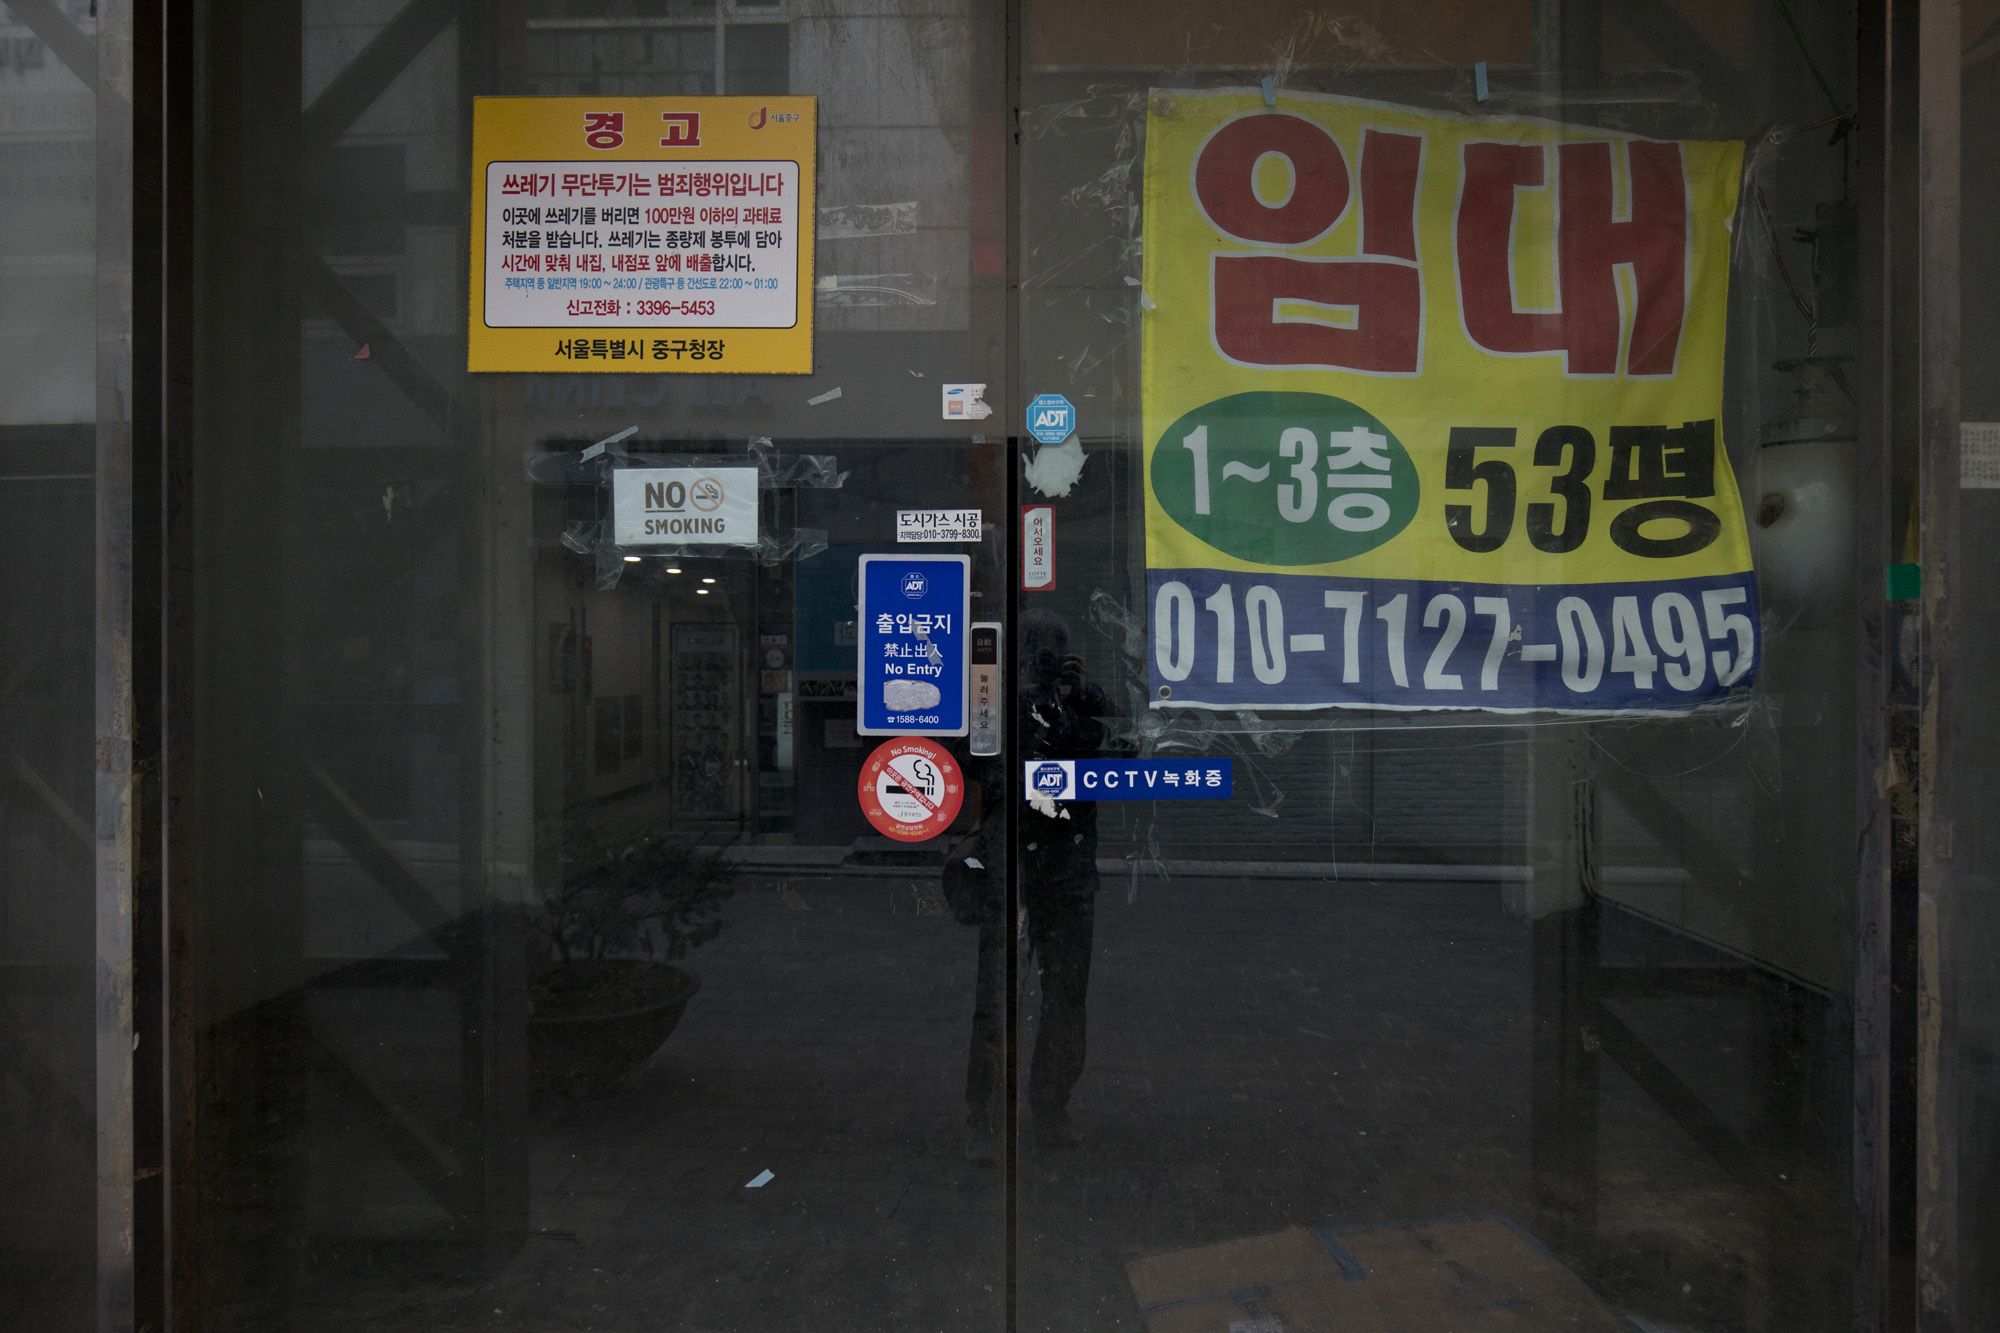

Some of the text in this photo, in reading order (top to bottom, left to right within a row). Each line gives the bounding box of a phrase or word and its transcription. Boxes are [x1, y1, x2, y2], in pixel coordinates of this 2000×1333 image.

[770, 113, 800, 123] 서울중구
[502, 173, 783, 197] 쓰레기 무단투기는 범죄행위입니다
[502, 207, 782, 225] 이곳에 쓰레기를 버리면 100만원 이하의 과태료
[502, 230, 782, 249] 처분을 받습니다. 쓰레기는 종량제 봉투에 담아
[1190, 109, 1692, 380] 임대
[502, 254, 755, 272] 시간에 맞춰 내집, 내점포 앞에 배출합시다.
[505, 278, 535, 290] 주택지역
[537, 278, 545, 290] 등
[547, 278, 577, 290] 일반지역
[579, 278, 602, 290] 19:00
[614, 278, 637, 290] 24:00
[644, 278, 675, 290] 관광특구
[677, 278, 685, 290] 등
[687, 278, 717, 290] 간선도로
[719, 278, 742, 290] 22:00
[754, 278, 778, 290] 01:00
[567, 300, 620, 316] 신고전화
[637, 300, 715, 316] 3396-5453
[555, 339, 724, 360] 서울특별시 중구청장
[1035, 410, 1067, 427] ADT
[1182, 424, 1393, 532] 1~3층
[645, 481, 686, 509] NO
[1444, 418, 1722, 559] 53평
[645, 518, 725, 535] SMOKING
[900, 513, 980, 528] 도시가스 시공
[1033, 517, 1043, 566] 어서오세요
[905, 581, 924, 590] ADT
[876, 613, 951, 634] 출입금지
[1154, 579, 1755, 693] 010-7127-0495
[884, 643, 943, 658] 禁止出入
[885, 663, 942, 678] No Entry
[980, 674, 989, 729] 눌러주세요
[896, 715, 939, 724] 1588-6400
[891, 745, 936, 760] No Smoking!
[886, 767, 935, 811] 이곳은 금연구역입니다
[1038, 774, 1062, 787] ADT
